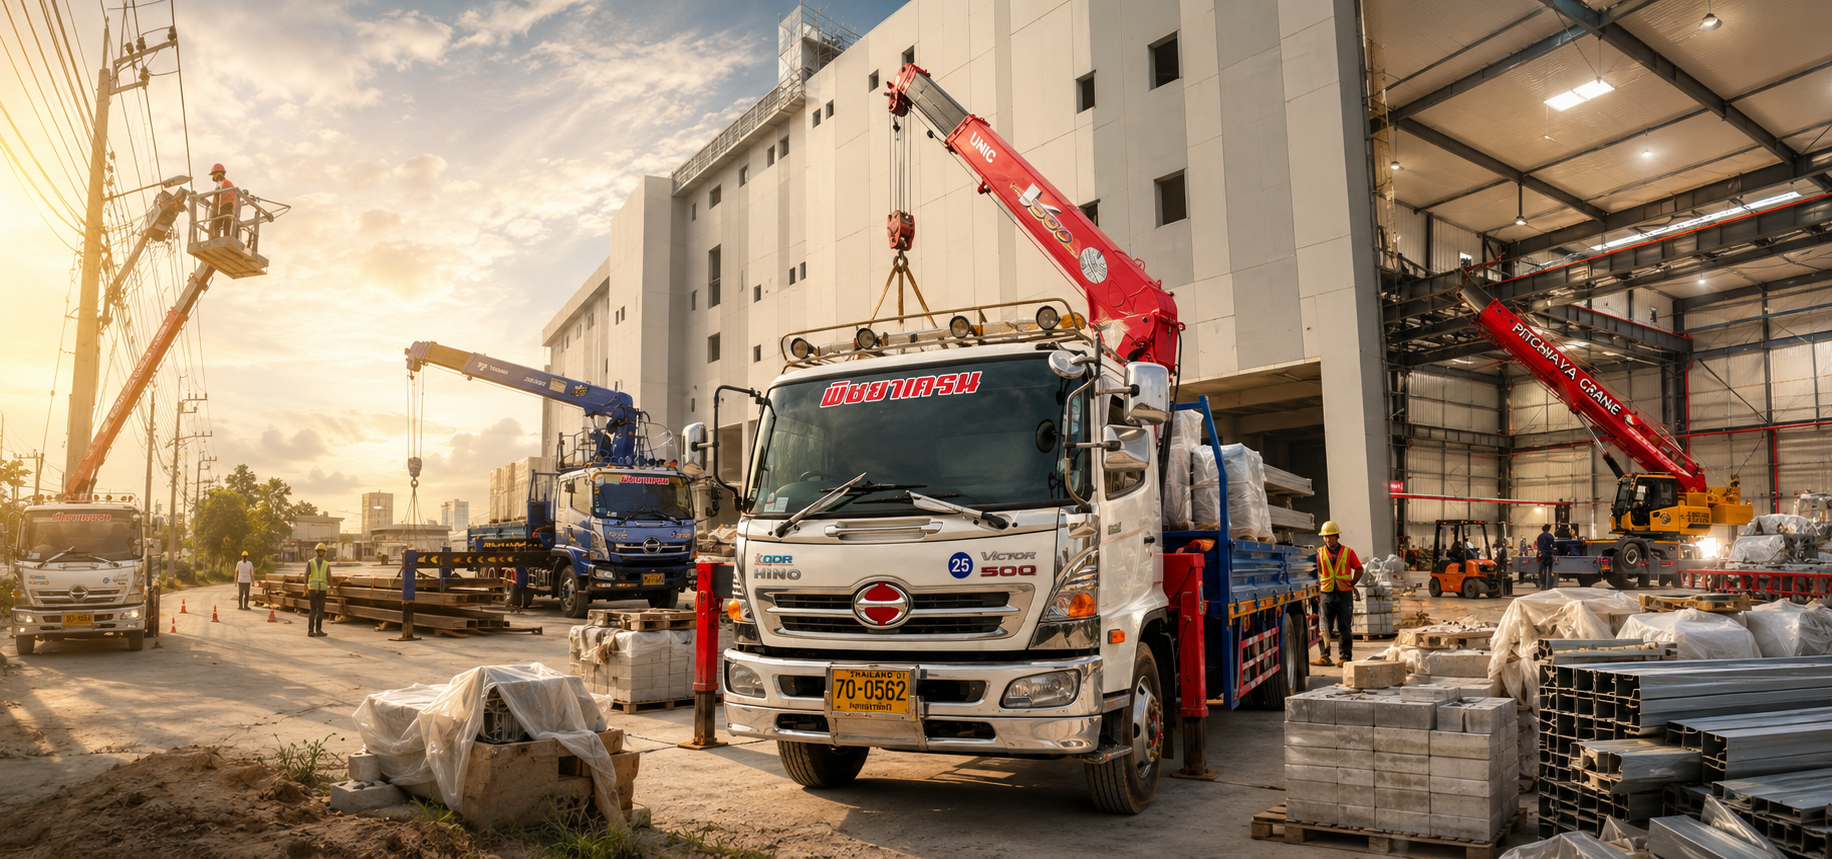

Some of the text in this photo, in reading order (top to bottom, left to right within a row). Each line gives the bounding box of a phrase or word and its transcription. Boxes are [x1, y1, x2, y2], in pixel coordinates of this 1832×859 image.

[969, 131, 997, 163] UNIC
[754, 568, 802, 580] HINO
[951, 558, 970, 573] 25
[836, 679, 906, 701] 70-0562
